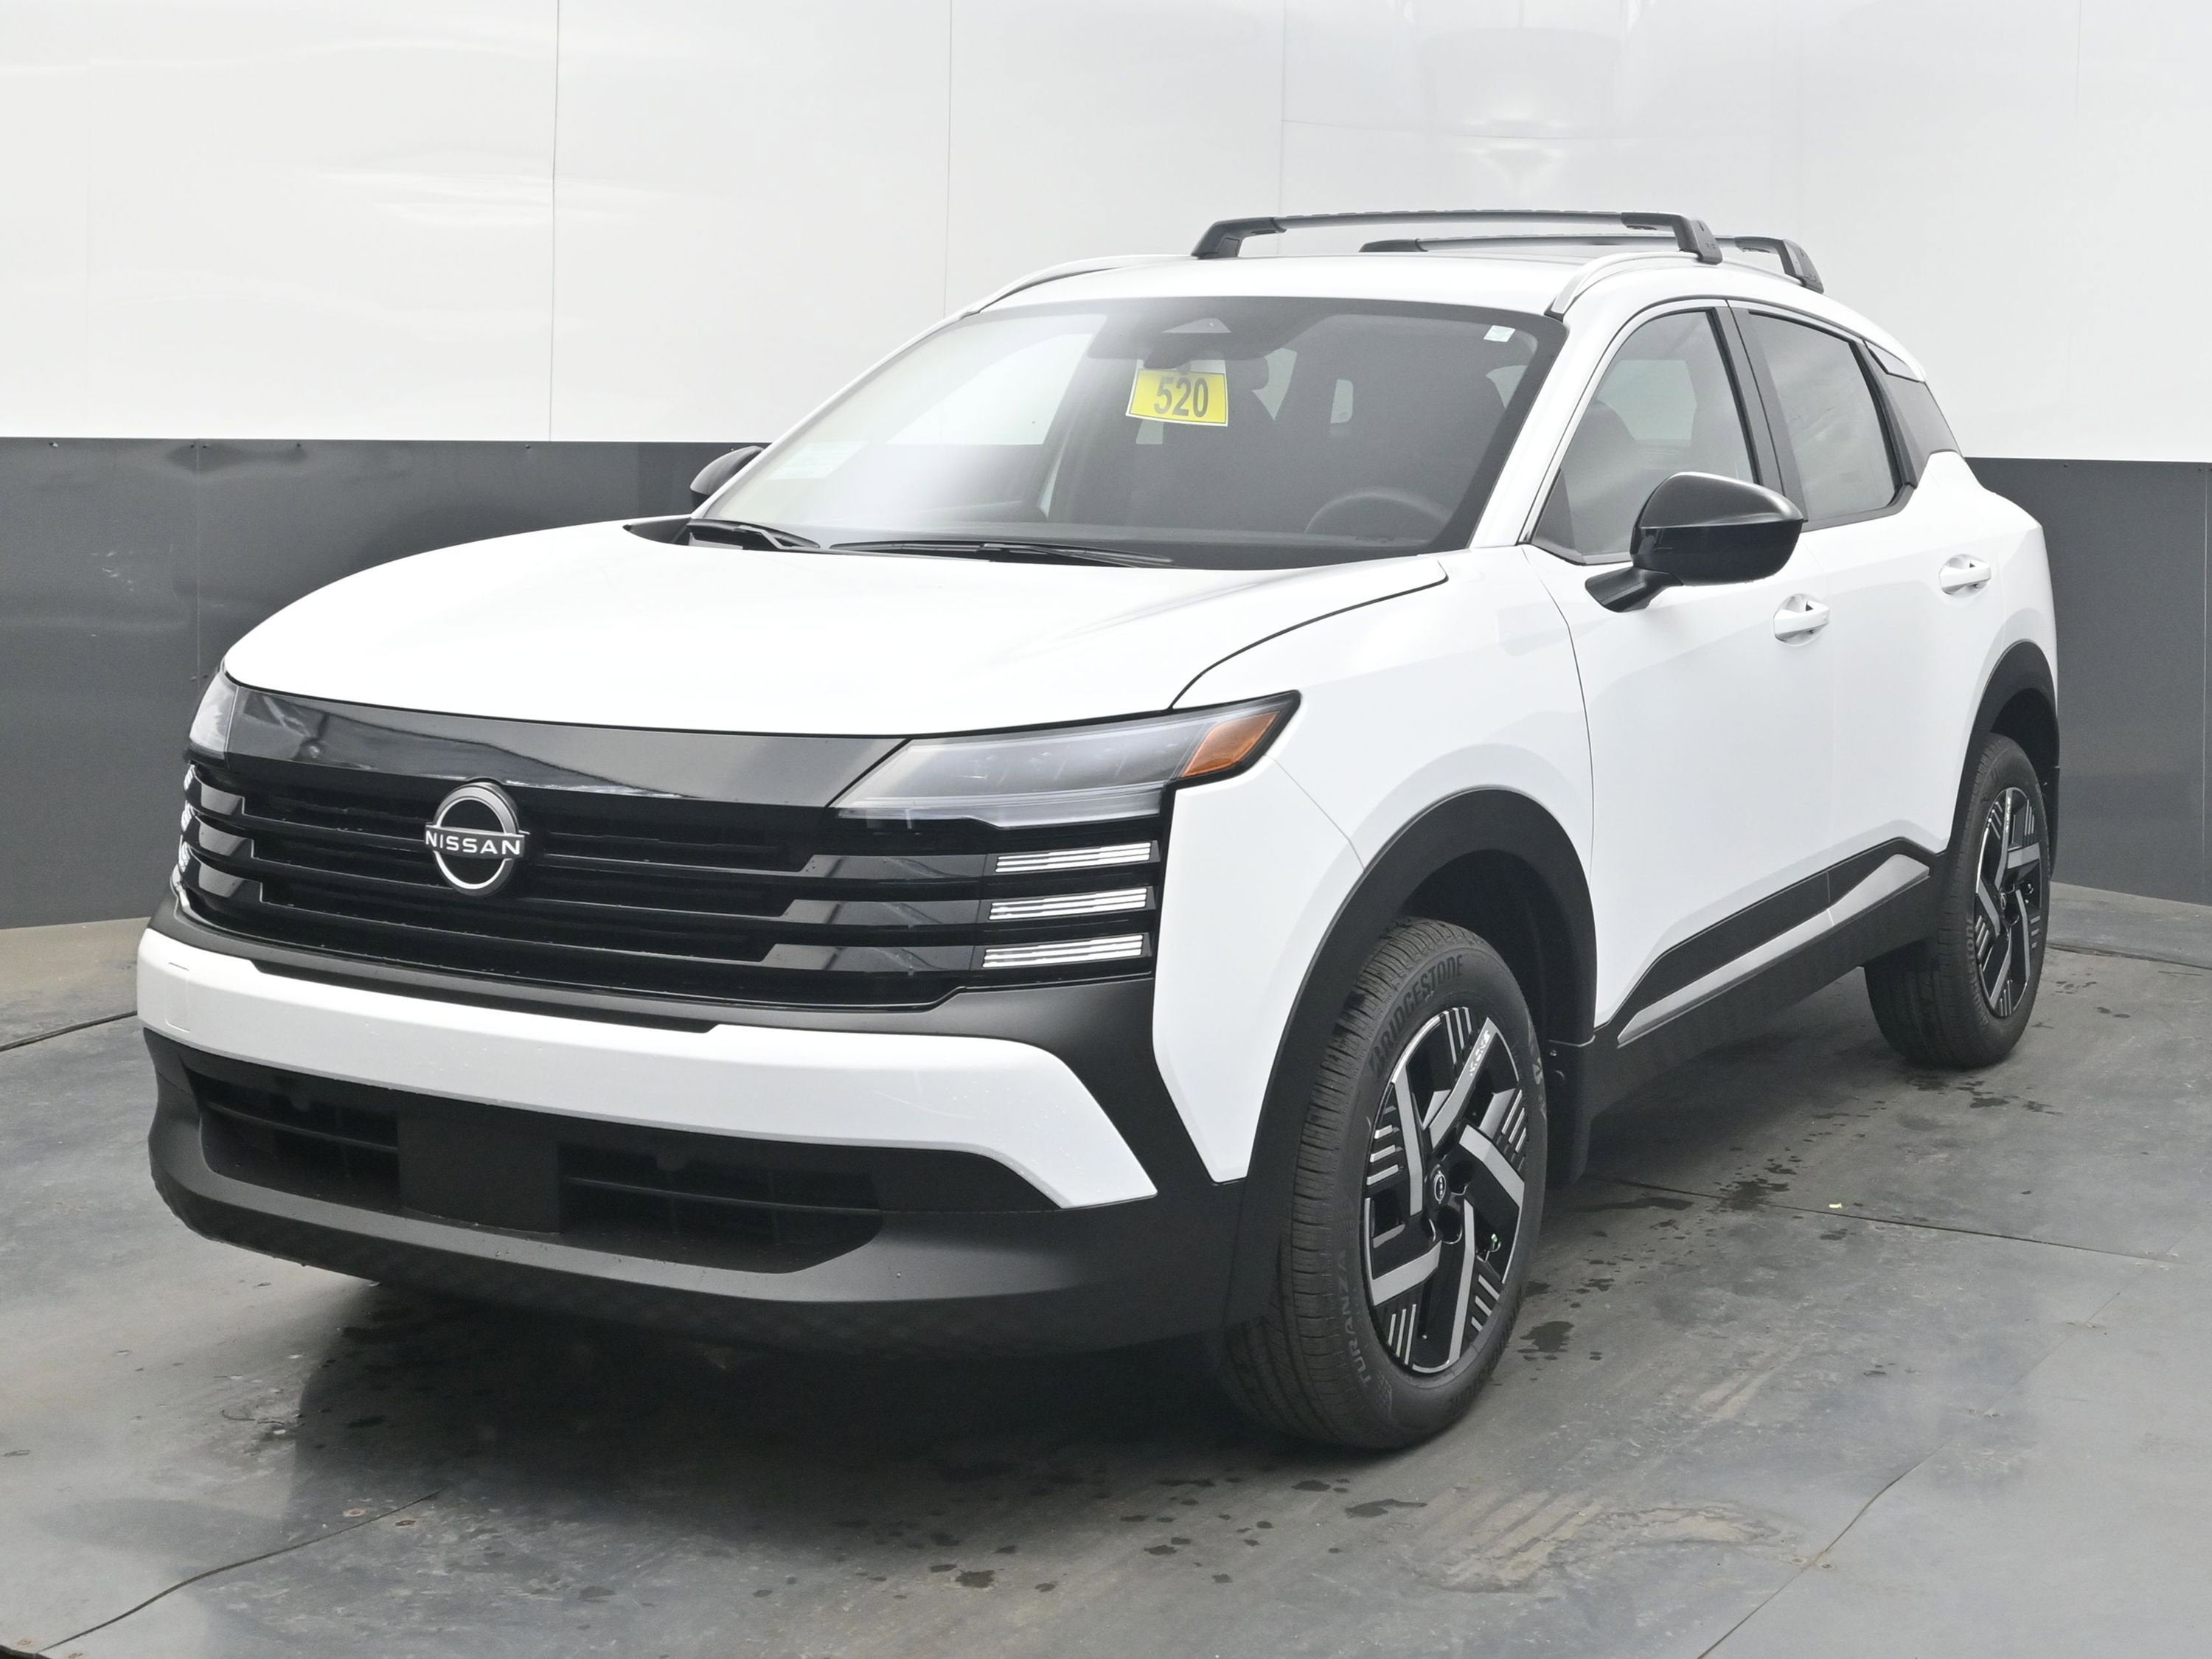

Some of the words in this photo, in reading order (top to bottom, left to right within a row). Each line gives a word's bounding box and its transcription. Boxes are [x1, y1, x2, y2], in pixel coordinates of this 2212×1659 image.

[1154, 376, 1208, 417] 520
[425, 830, 520, 855] NISSAN
[1369, 954, 1463, 1078] BRIDGESTONE
[1338, 1251, 1372, 1388] TURANZA
